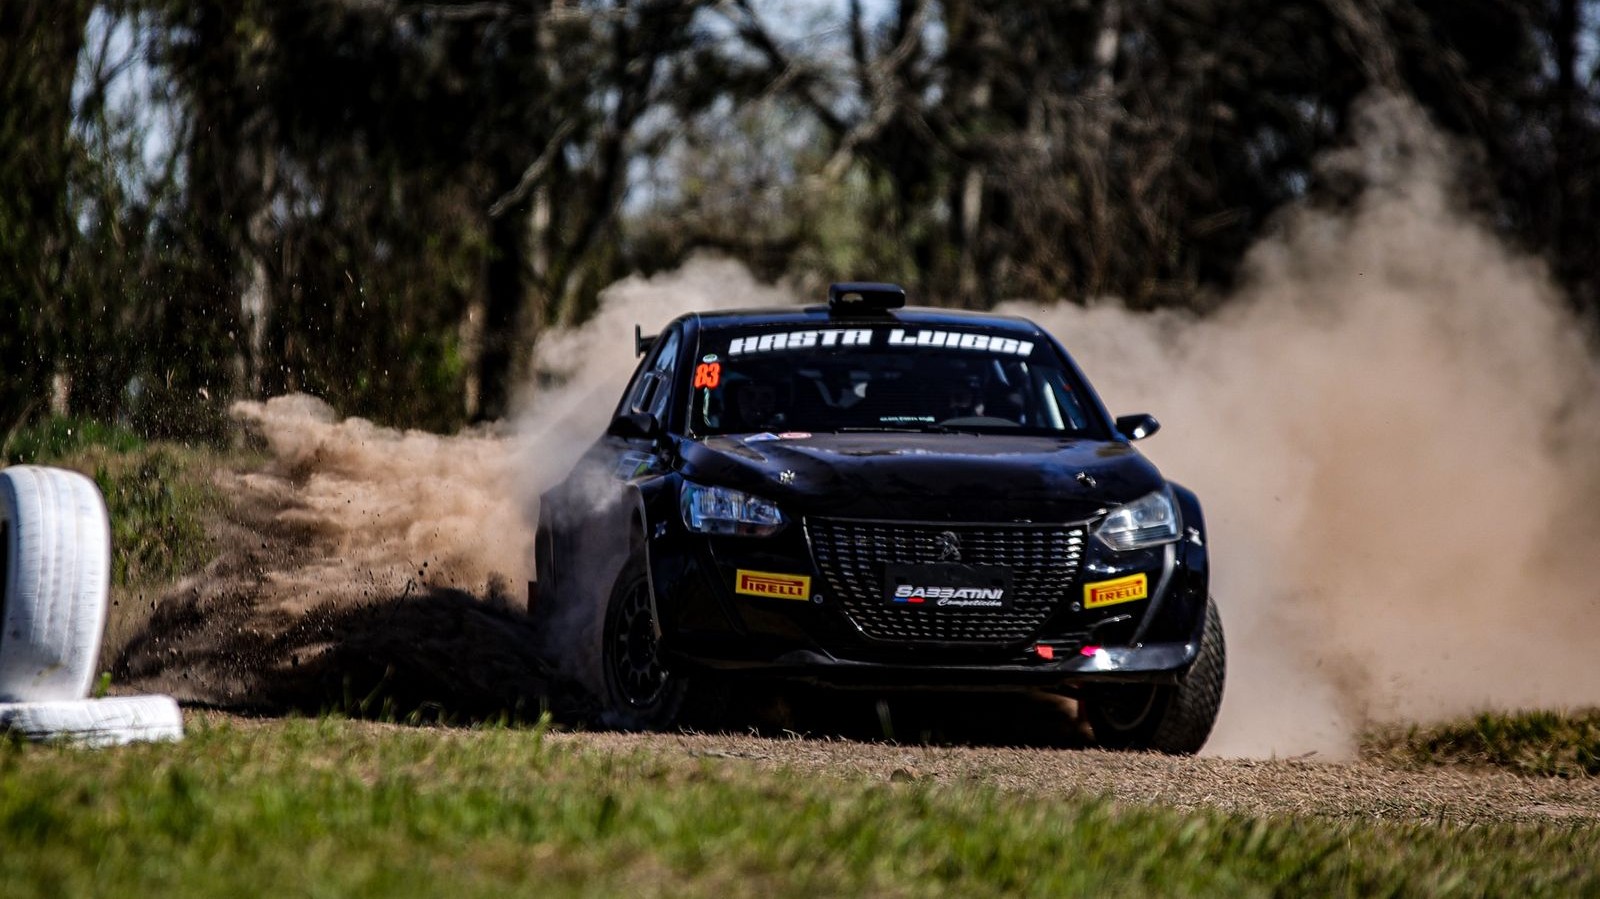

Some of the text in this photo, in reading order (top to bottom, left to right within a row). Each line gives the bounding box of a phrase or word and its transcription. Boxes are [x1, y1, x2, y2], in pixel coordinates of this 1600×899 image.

[728, 328, 1034, 356] HASTA LUIGGI
[694, 362, 721, 389] 83
[741, 574, 804, 596] PIRELLI
[894, 584, 1004, 600] SABBATINI
[1089, 579, 1143, 602] PIRELLI
